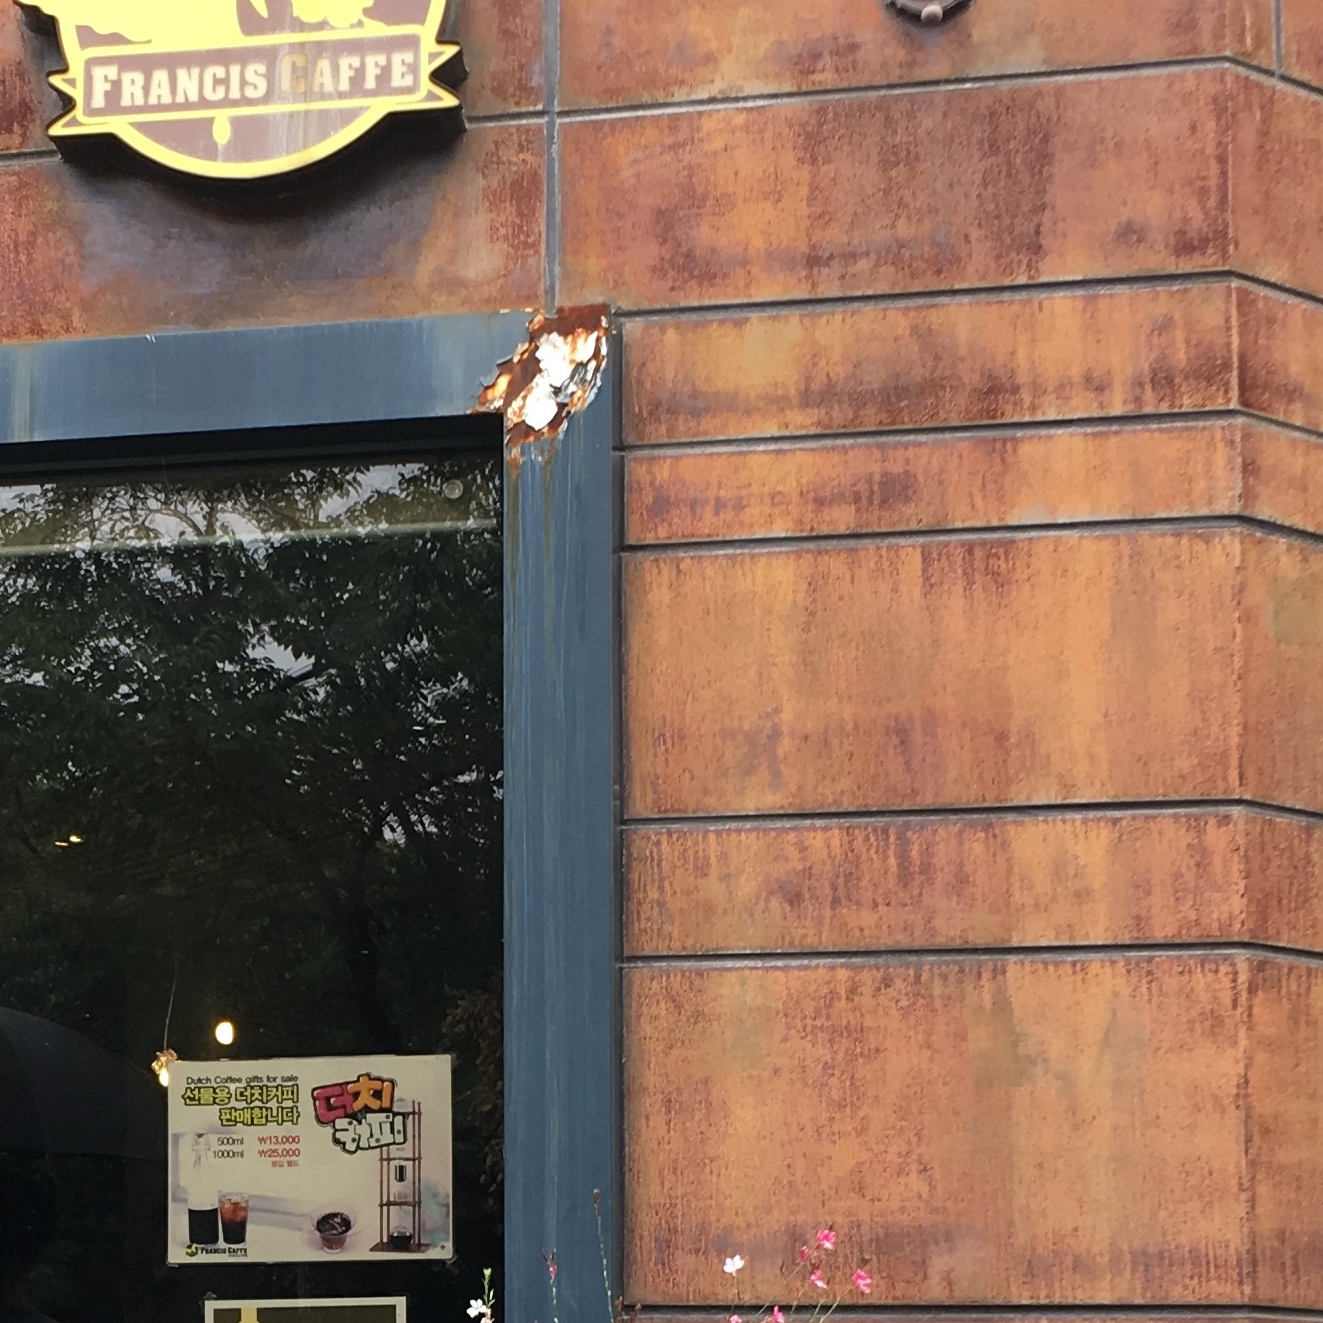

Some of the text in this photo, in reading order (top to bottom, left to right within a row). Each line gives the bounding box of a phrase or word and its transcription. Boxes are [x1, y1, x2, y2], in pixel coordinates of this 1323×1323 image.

[90, 50, 415, 109] FRANCIS CAFFE
[186, 1073, 299, 1085] Dutch Coffee gifts for sale
[181, 1083, 299, 1106] 선물용 더치커피
[311, 1073, 395, 1124] 더치
[219, 1104, 301, 1127] 판매합니다
[217, 1135, 301, 1146] 500ml ₩13,000
[334, 1111, 407, 1153] 커피
[213, 1148, 301, 1158] 1000ml ₩25,000
